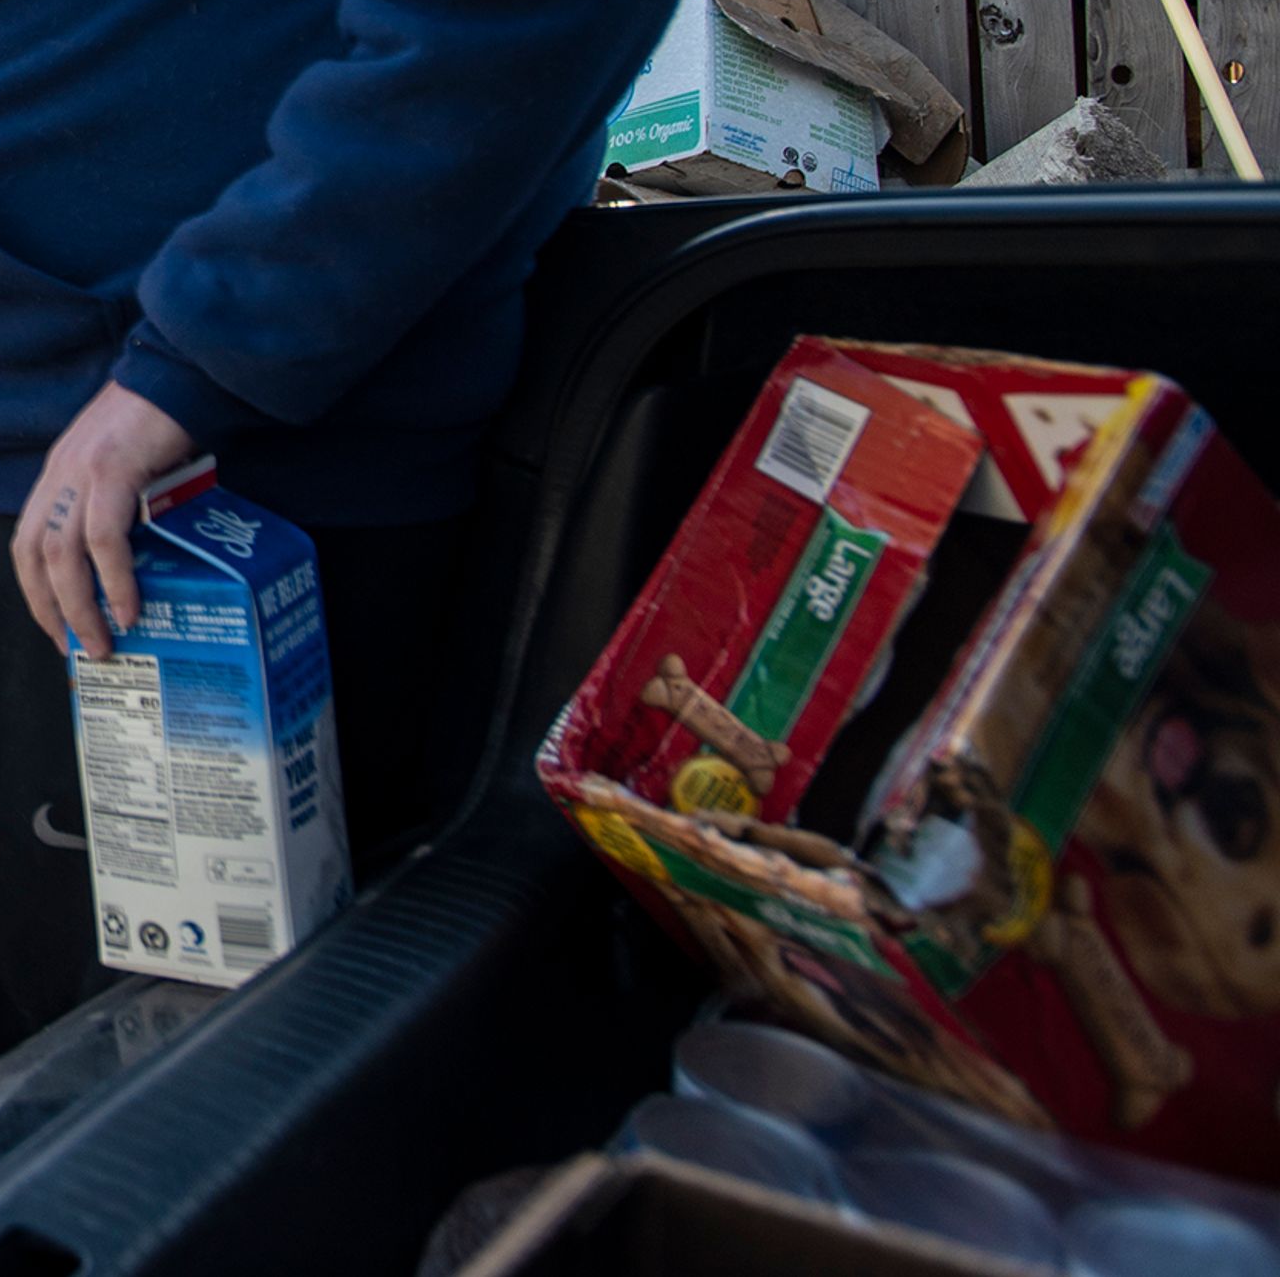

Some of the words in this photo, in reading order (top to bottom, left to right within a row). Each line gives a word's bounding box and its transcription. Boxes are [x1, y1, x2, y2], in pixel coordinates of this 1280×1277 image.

[608, 126, 647, 149] 100%
[649, 115, 694, 143] Organic
[194, 507, 262, 558] Silk
[805, 538, 874, 622] Large
[1113, 566, 1198, 680] Large
